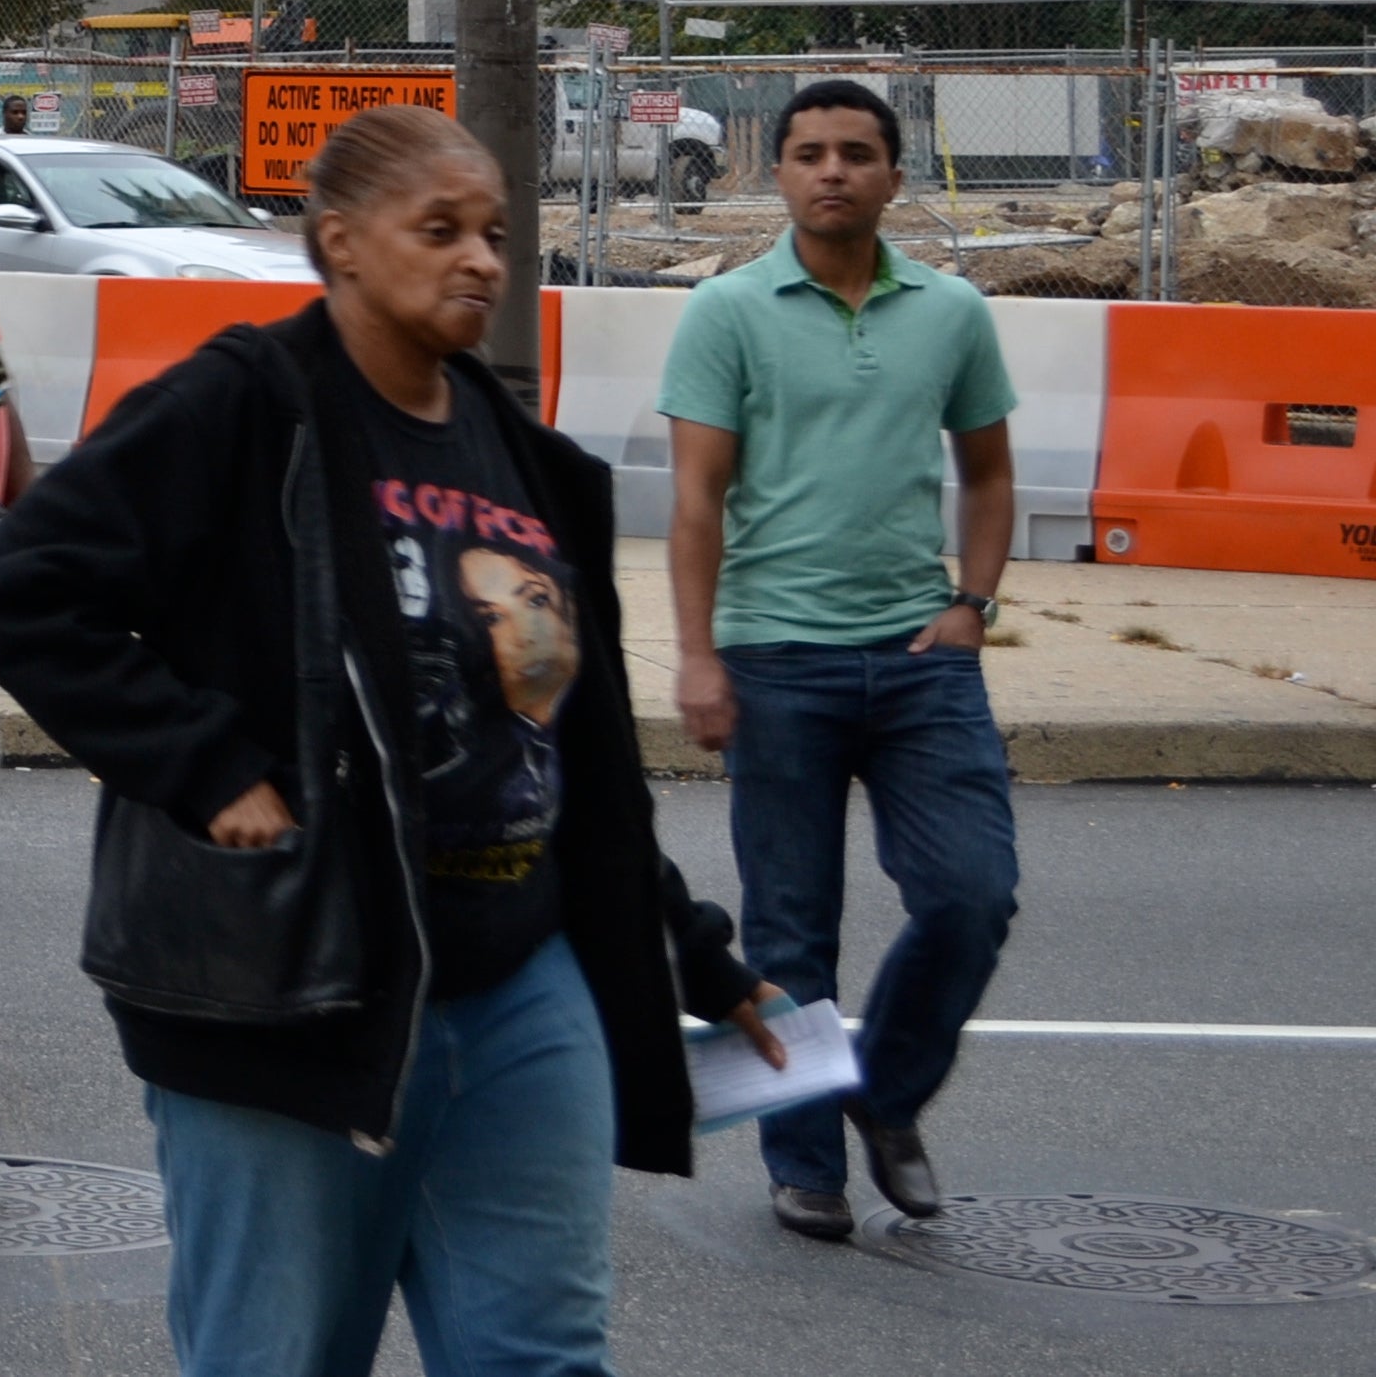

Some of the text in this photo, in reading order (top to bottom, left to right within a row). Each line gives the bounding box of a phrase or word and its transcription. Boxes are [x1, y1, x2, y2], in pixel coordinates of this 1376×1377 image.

[1178, 73, 1270, 91] SAFETY
[267, 85, 321, 111] ACTIVE
[329, 85, 394, 111] TRAFFIC
[631, 94, 678, 107] NORTHEAST
[258, 121, 279, 146] DO
[287, 121, 317, 147] NOT
